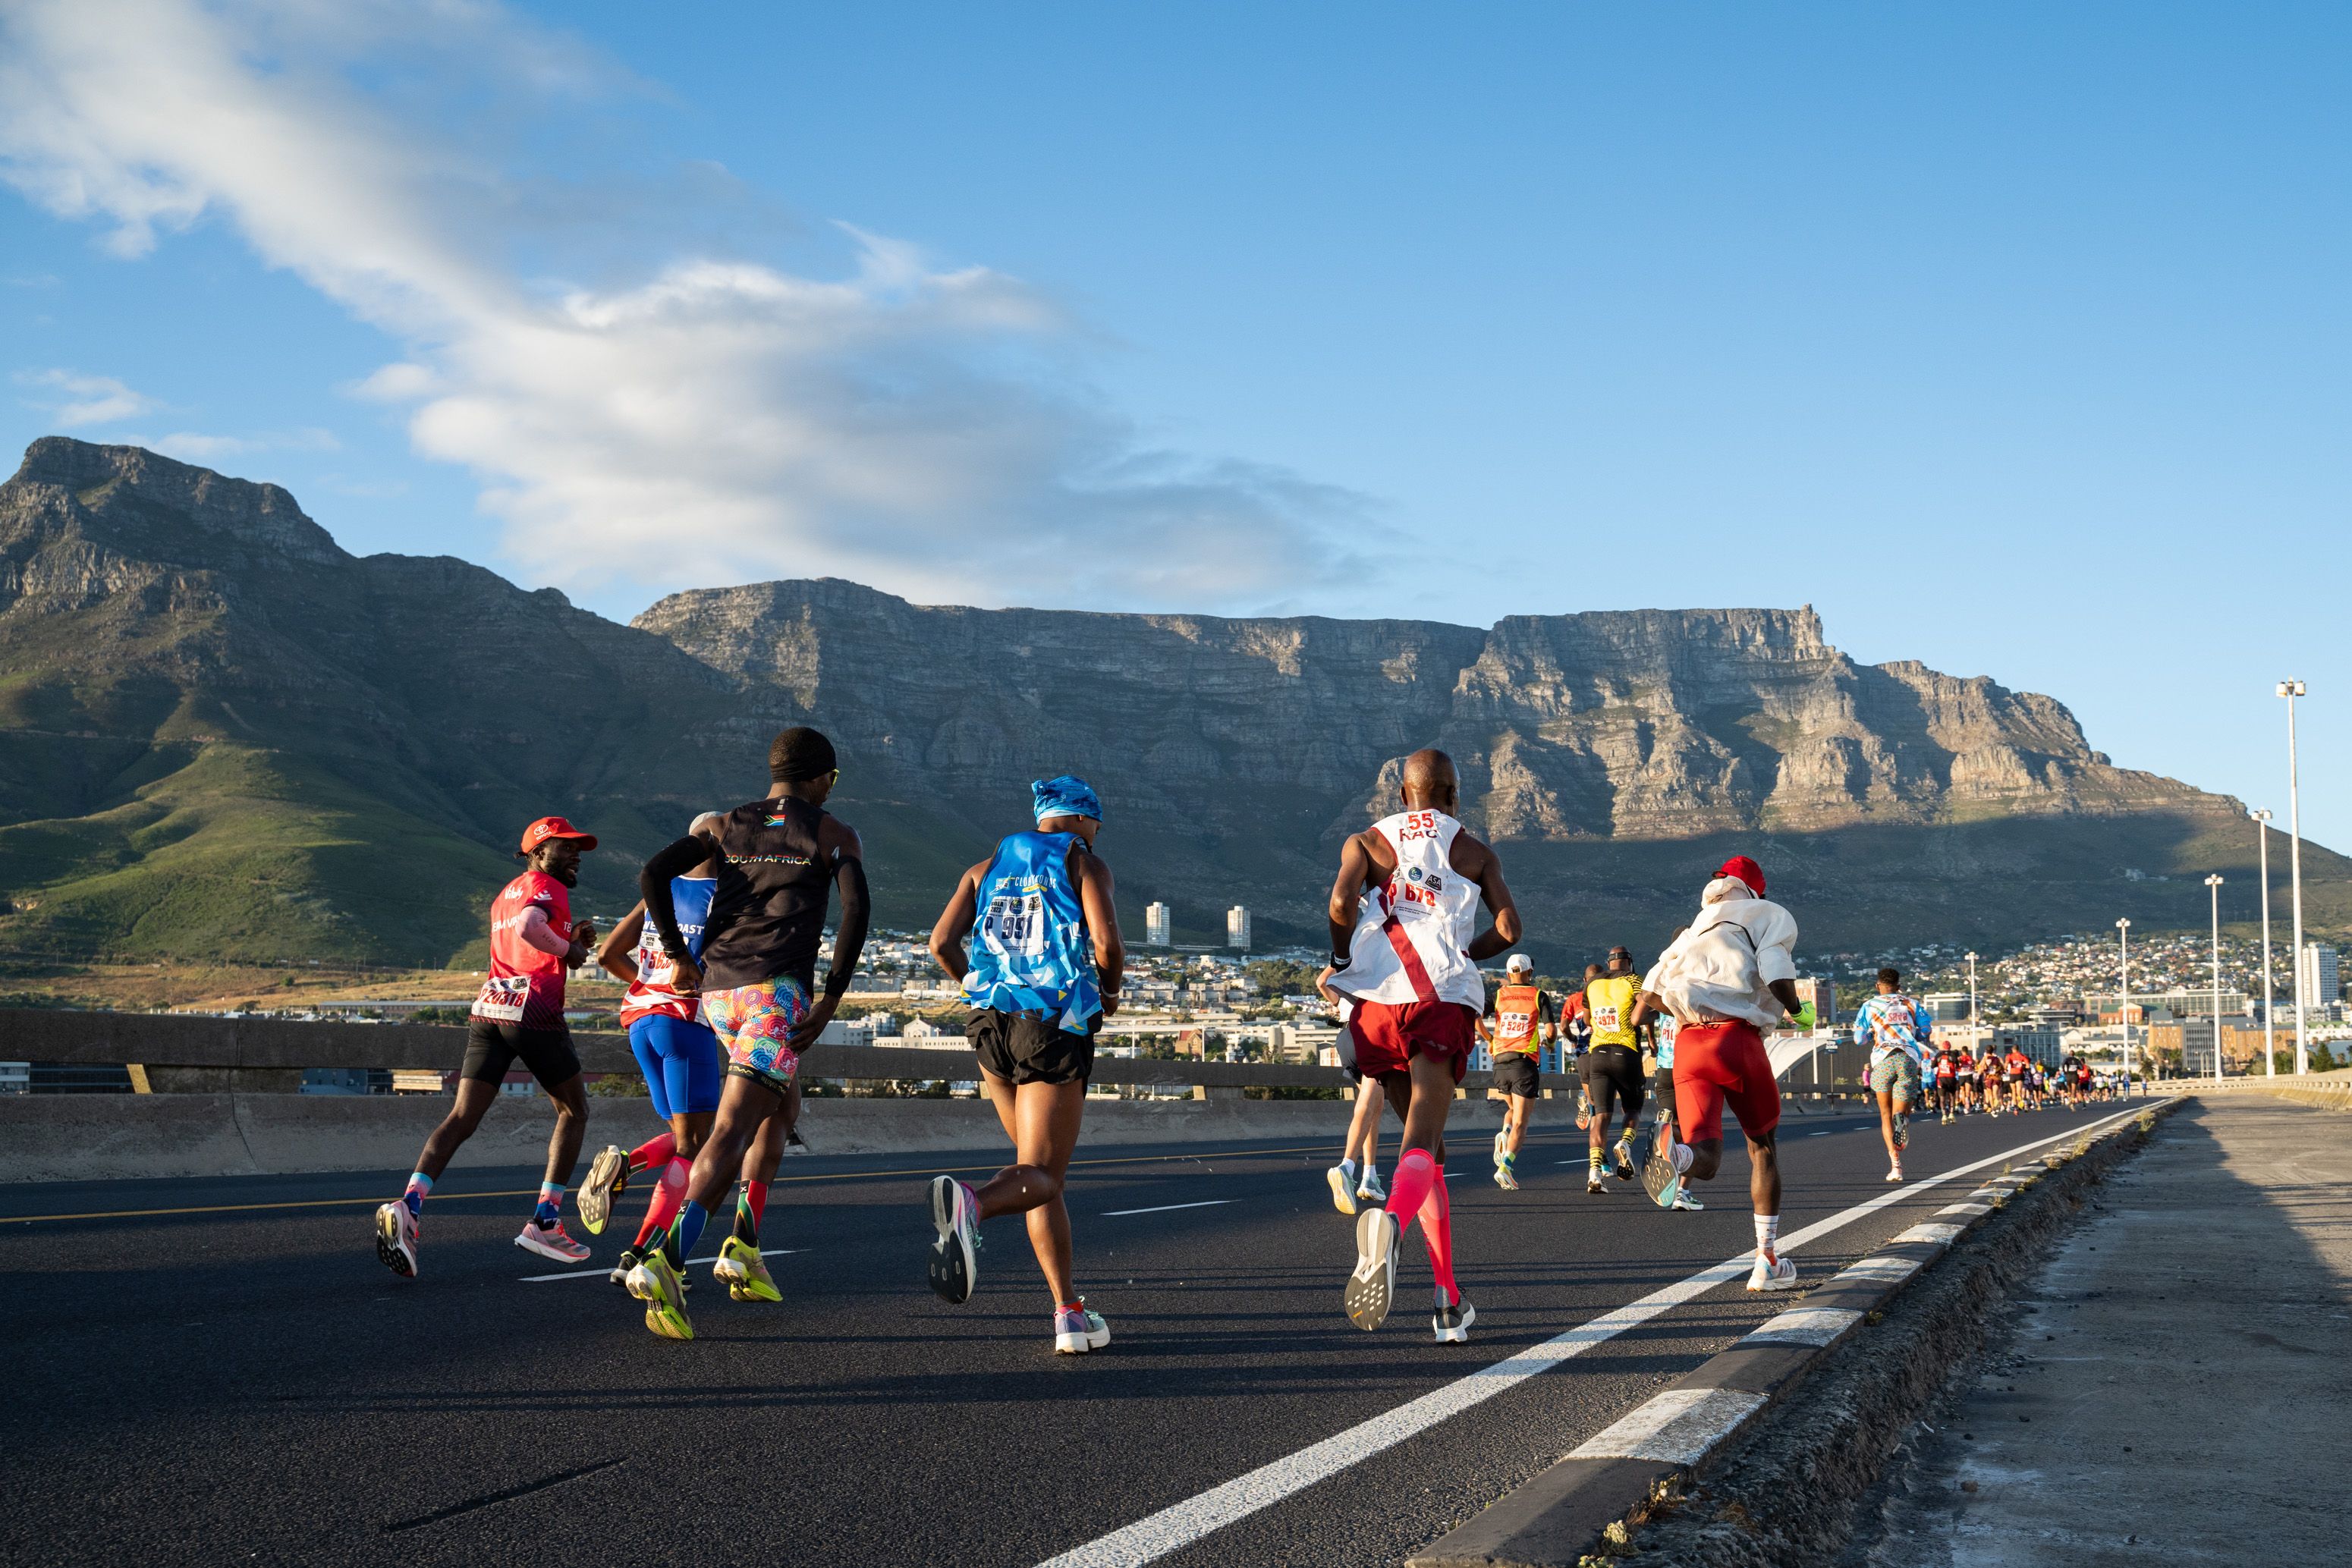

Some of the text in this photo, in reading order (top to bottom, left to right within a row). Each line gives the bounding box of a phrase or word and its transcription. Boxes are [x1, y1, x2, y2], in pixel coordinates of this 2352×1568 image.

[1408, 812, 1434, 831] 55
[536, 831, 552, 841] TOYOTA
[1399, 828, 1438, 842] RAC
[725, 853, 812, 866] SOUTH AFRICA
[1427, 875, 1442, 886] ASA
[1388, 883, 1398, 907] P
[1405, 883, 1436, 907] 673
[492, 919, 506, 933] EAM
[643, 920, 704, 935] WE OAST
[984, 916, 994, 937] P
[640, 948, 648, 963] P
